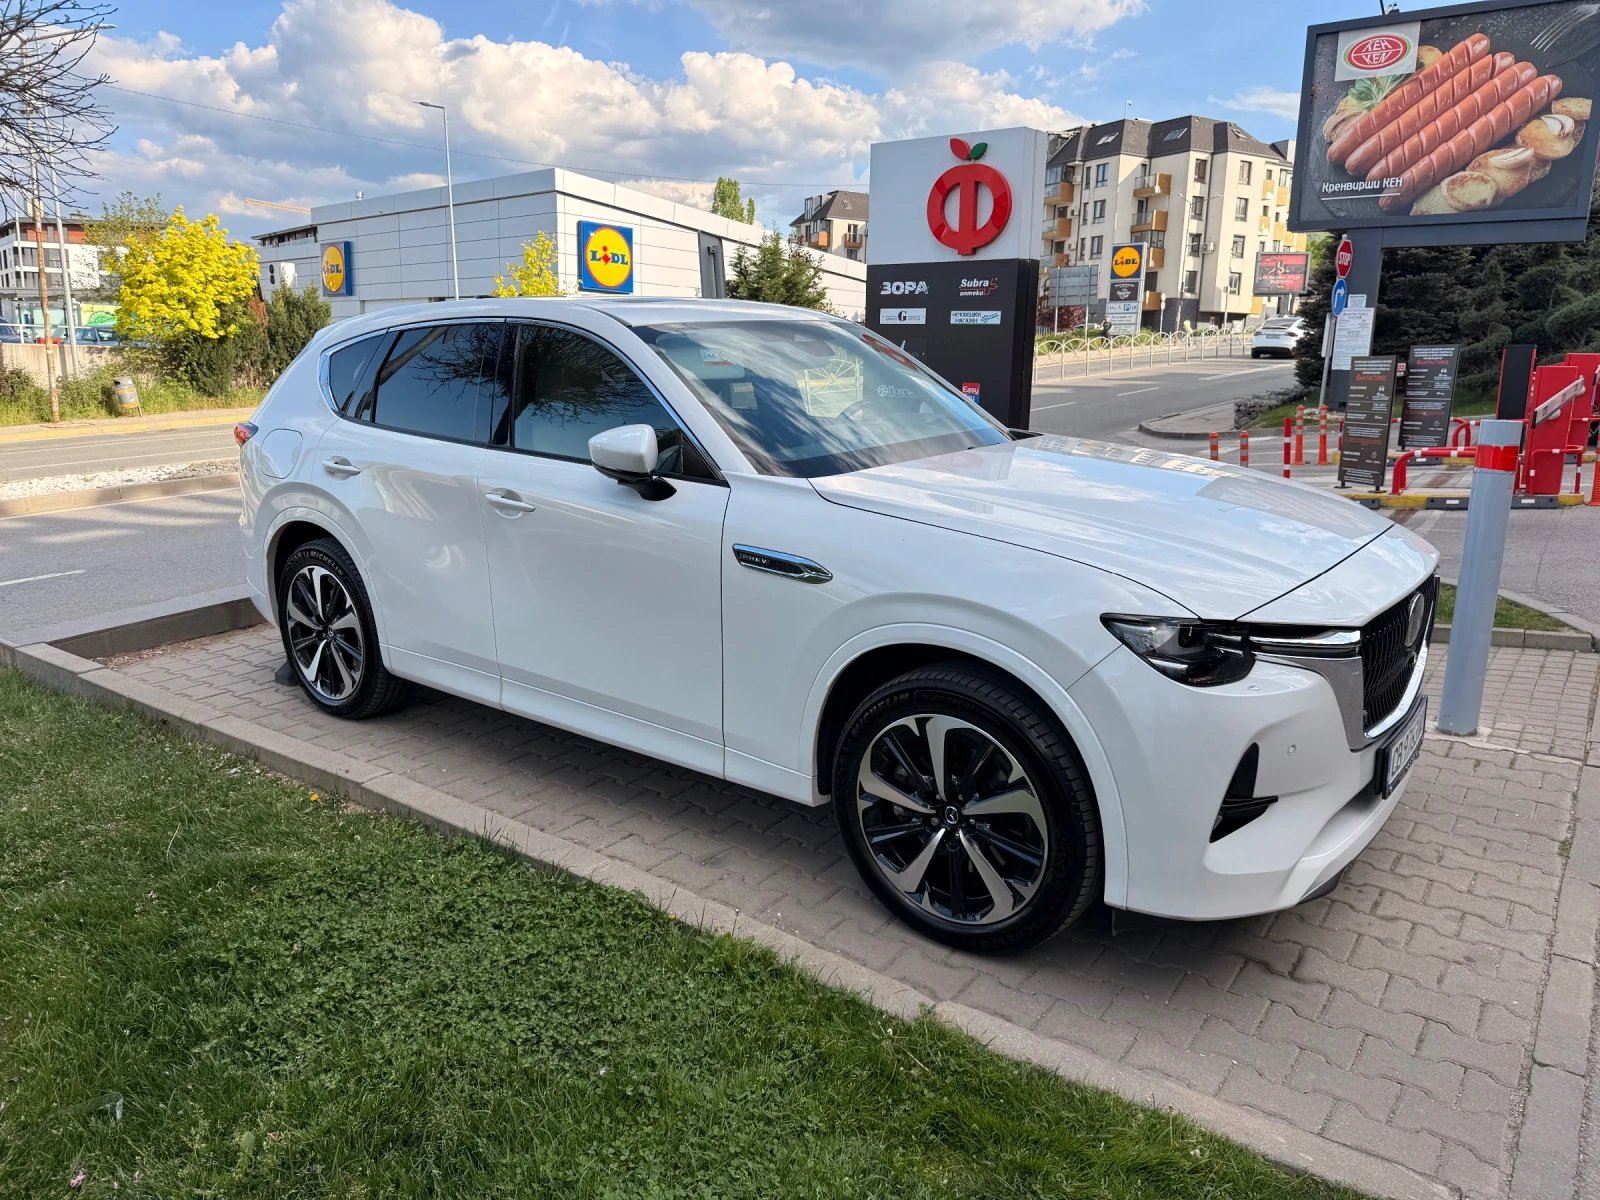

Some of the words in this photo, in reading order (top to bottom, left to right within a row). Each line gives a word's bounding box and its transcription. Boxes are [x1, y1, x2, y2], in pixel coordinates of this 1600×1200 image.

[1362, 39, 1393, 52] КЕН
[1362, 51, 1393, 64] KEN
[1321, 180, 1381, 194] Кренвирши
[1382, 177, 1403, 188] КЕН
[1339, 251, 1351, 266] STOP
[880, 280, 929, 295] ЗОРА
[960, 278, 990, 288] Subra
[898, 310, 907, 322] G
[962, 385, 980, 395] Easy
[310, 551, 344, 576] MICHELIN
[921, 693, 946, 703] PILOT
